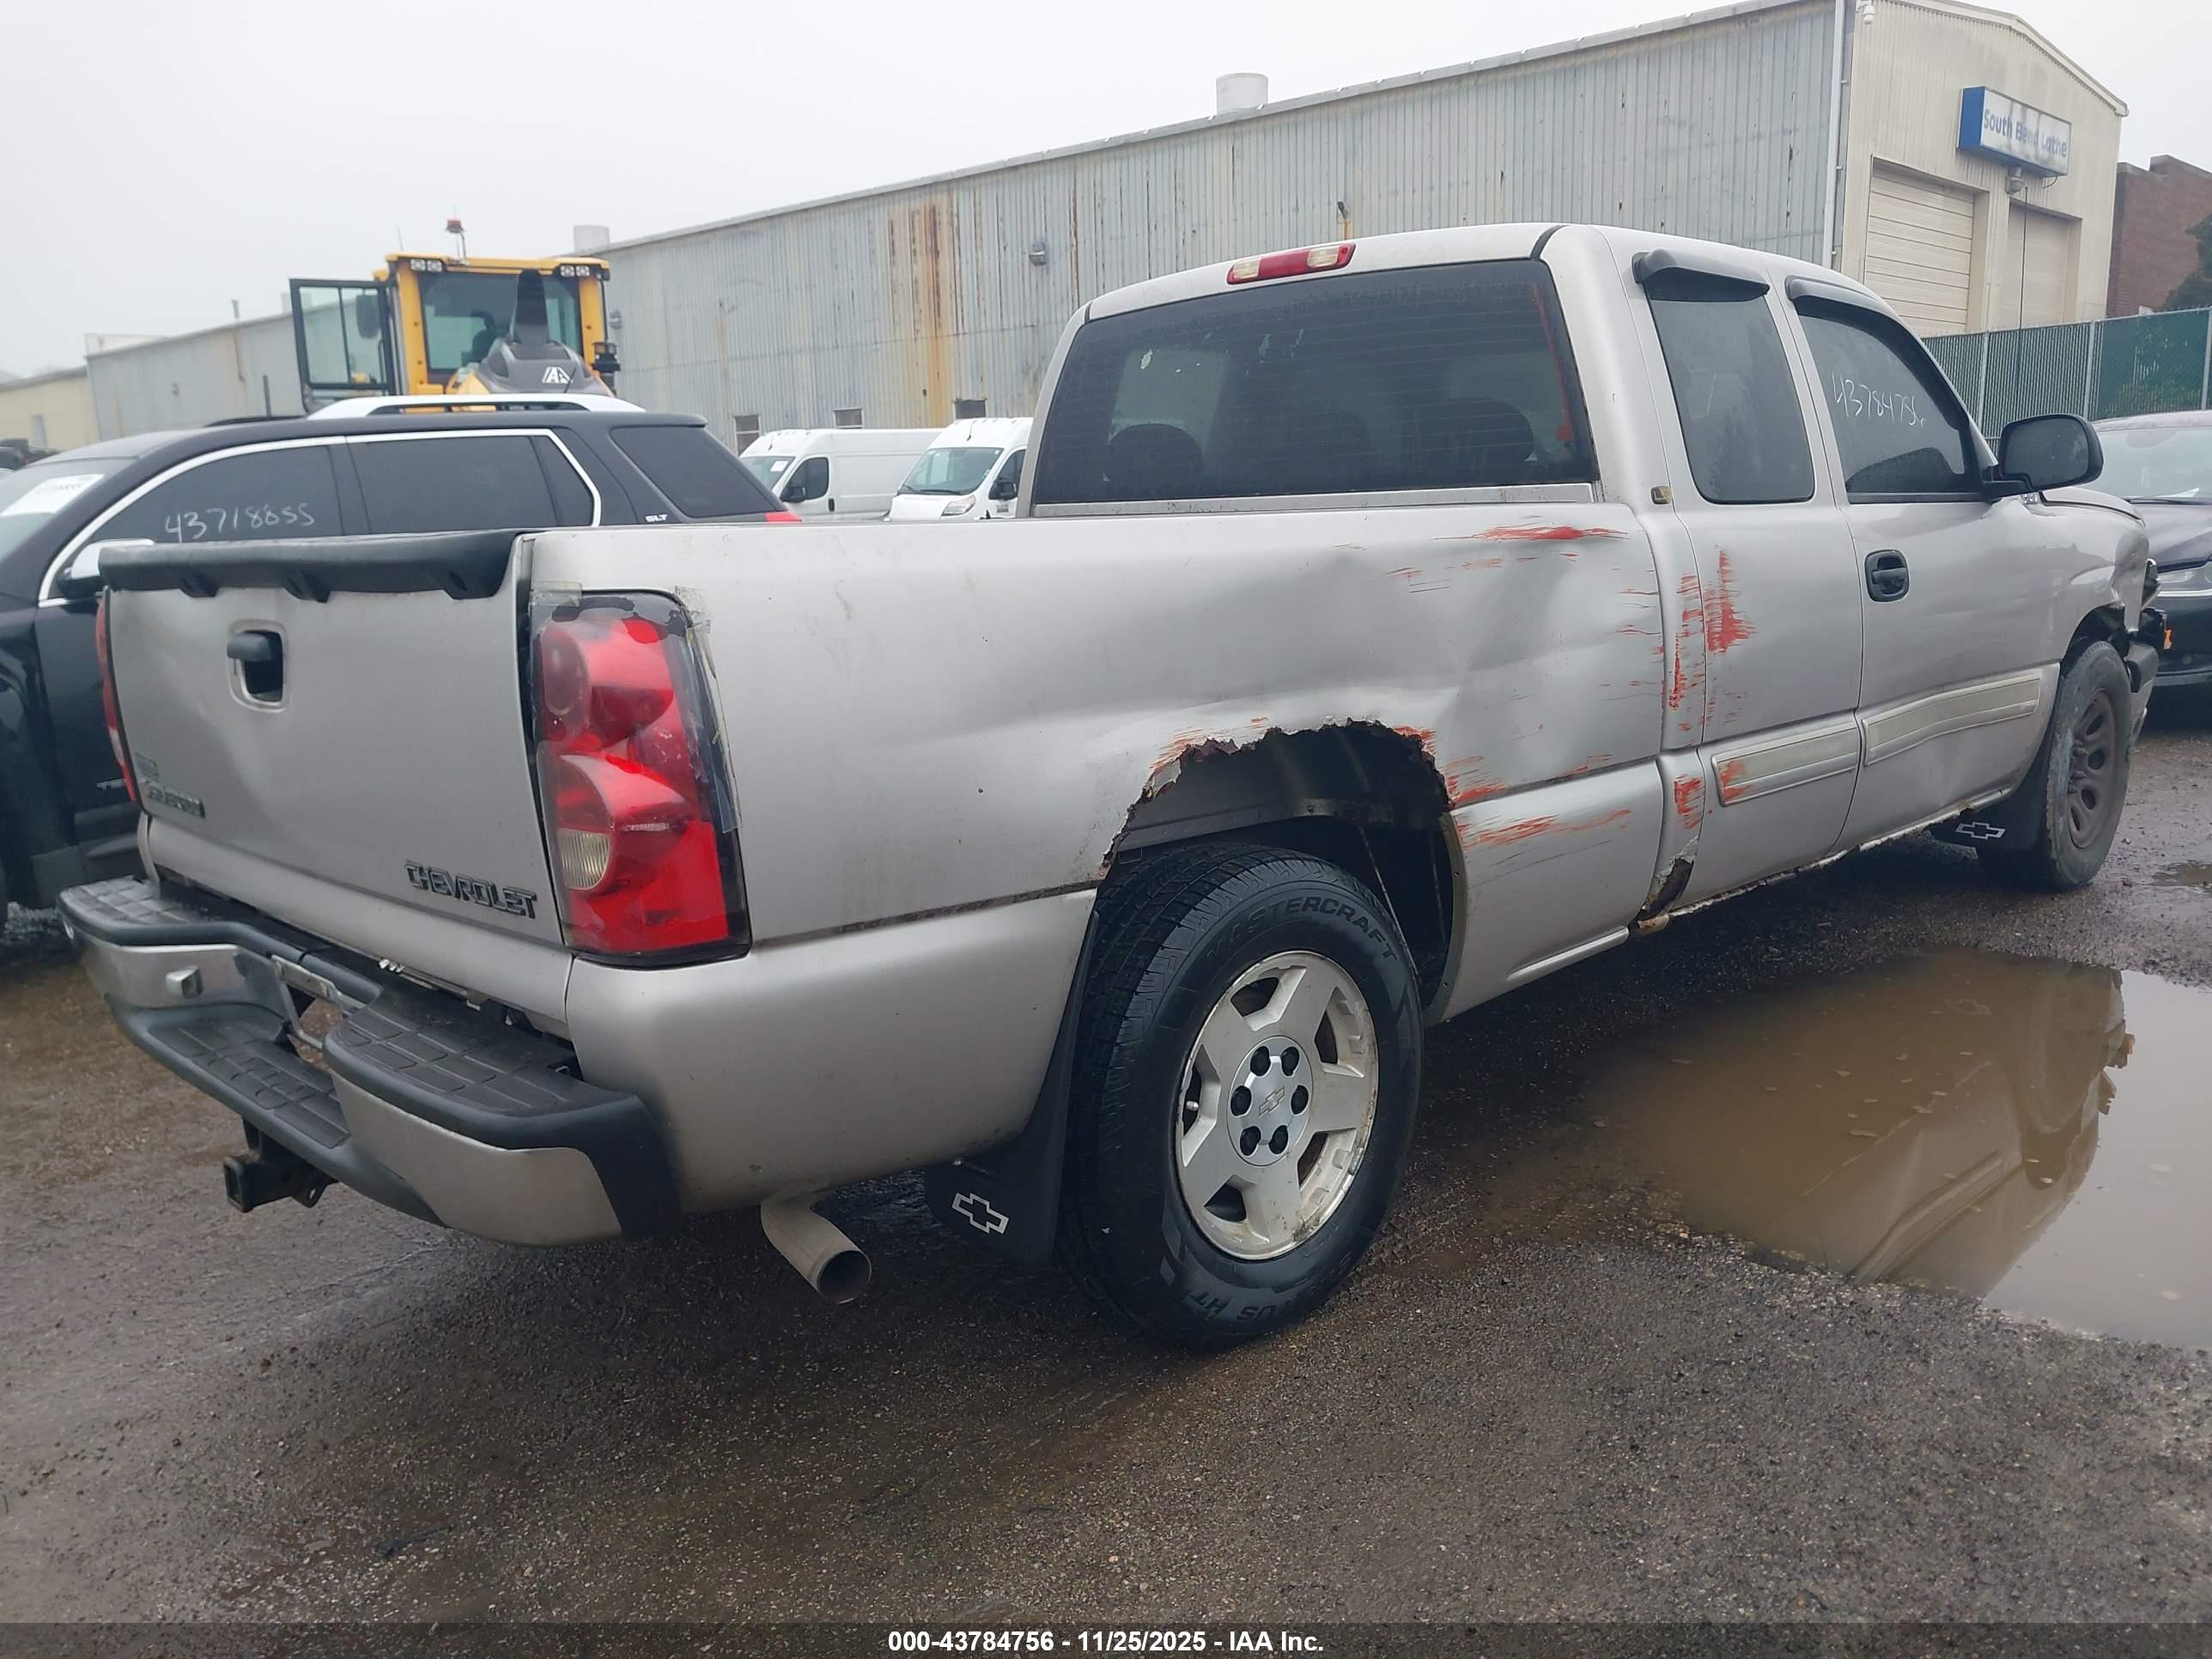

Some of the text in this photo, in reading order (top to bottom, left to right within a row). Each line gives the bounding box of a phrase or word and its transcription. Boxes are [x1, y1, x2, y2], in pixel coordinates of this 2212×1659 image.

[1984, 108, 2013, 138] South
[2015, 121, 2039, 145] Bend
[404, 860, 538, 920] CHEVROLET
